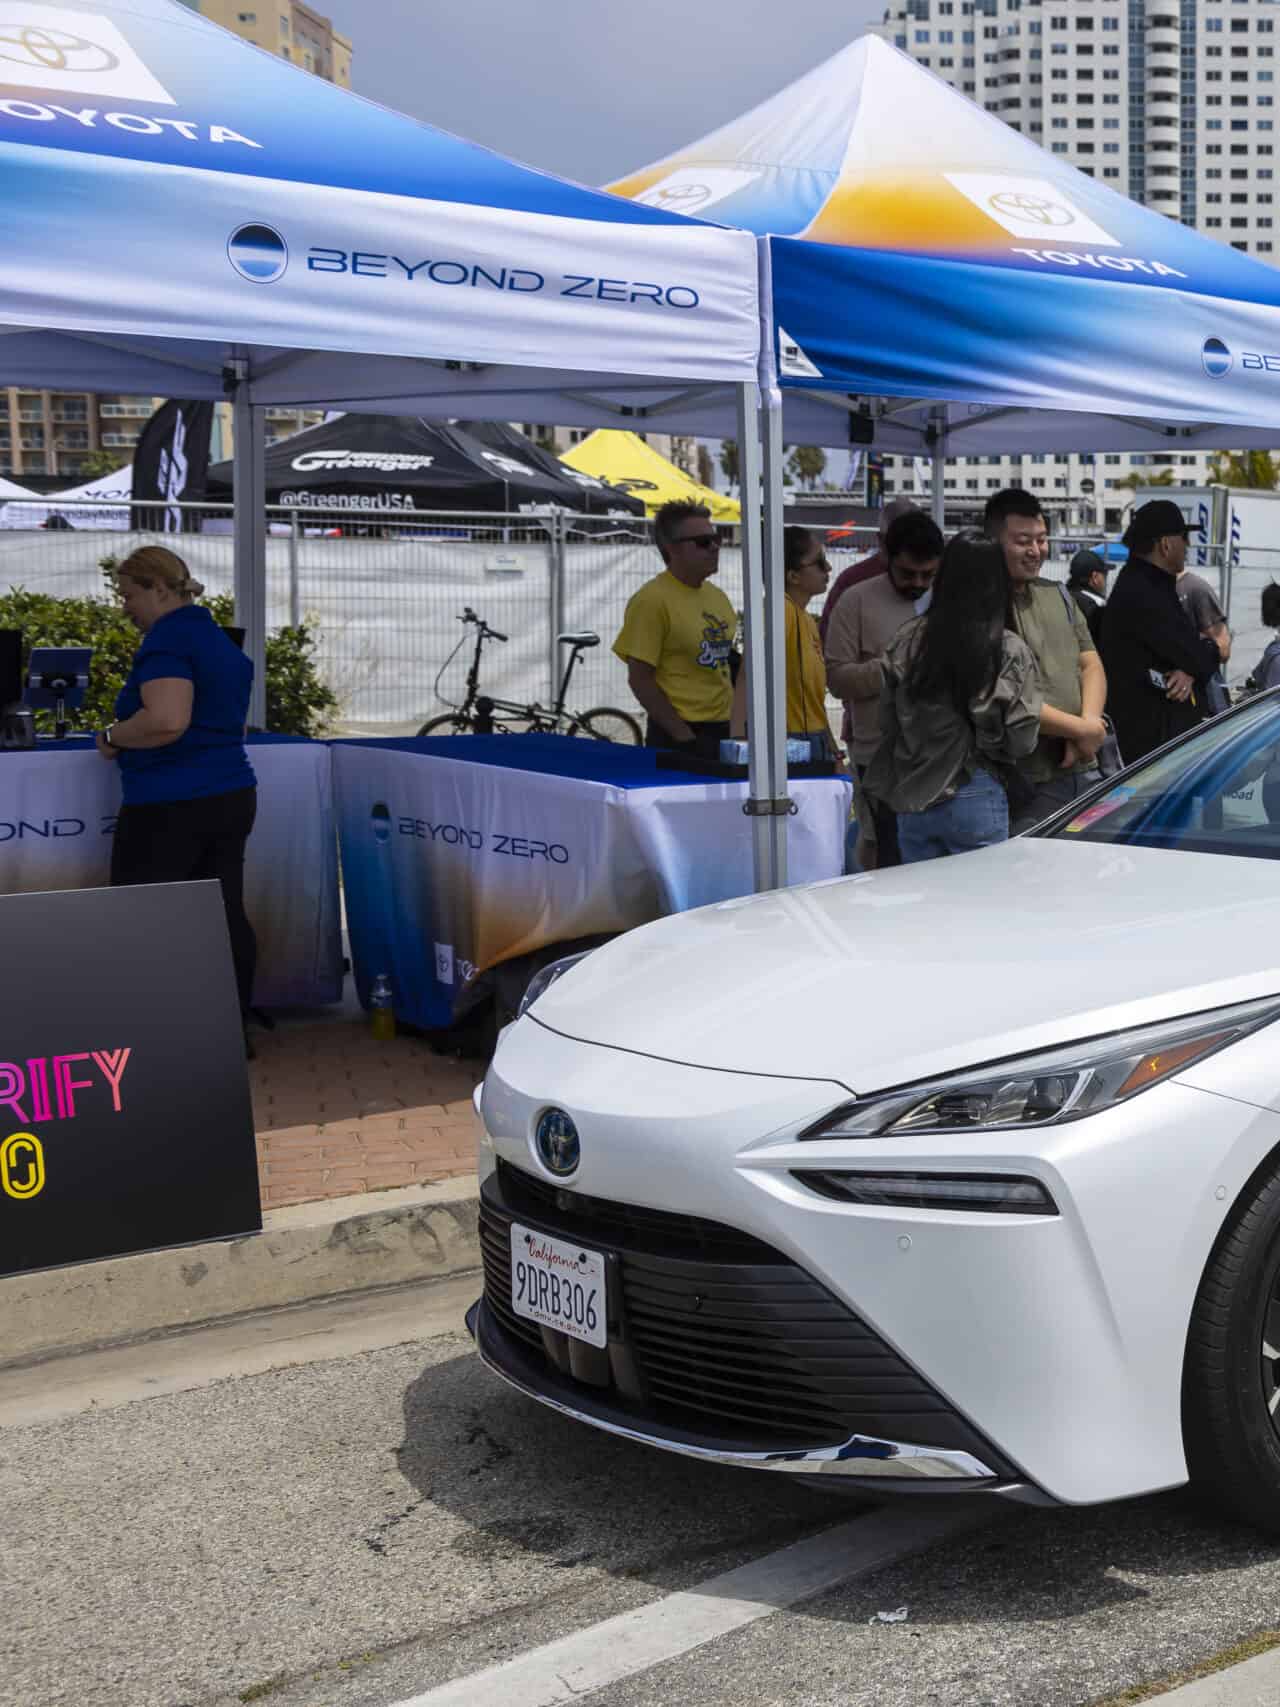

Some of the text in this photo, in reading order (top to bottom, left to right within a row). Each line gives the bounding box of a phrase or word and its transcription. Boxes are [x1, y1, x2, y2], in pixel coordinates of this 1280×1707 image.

[307, 247, 700, 309] BEYOND ZERO
[1010, 247, 1189, 279] TOYOTA
[399, 817, 569, 864] BEYOND ZERO
[528, 1237, 579, 1270] California
[516, 1261, 597, 1331] 9DRB306
